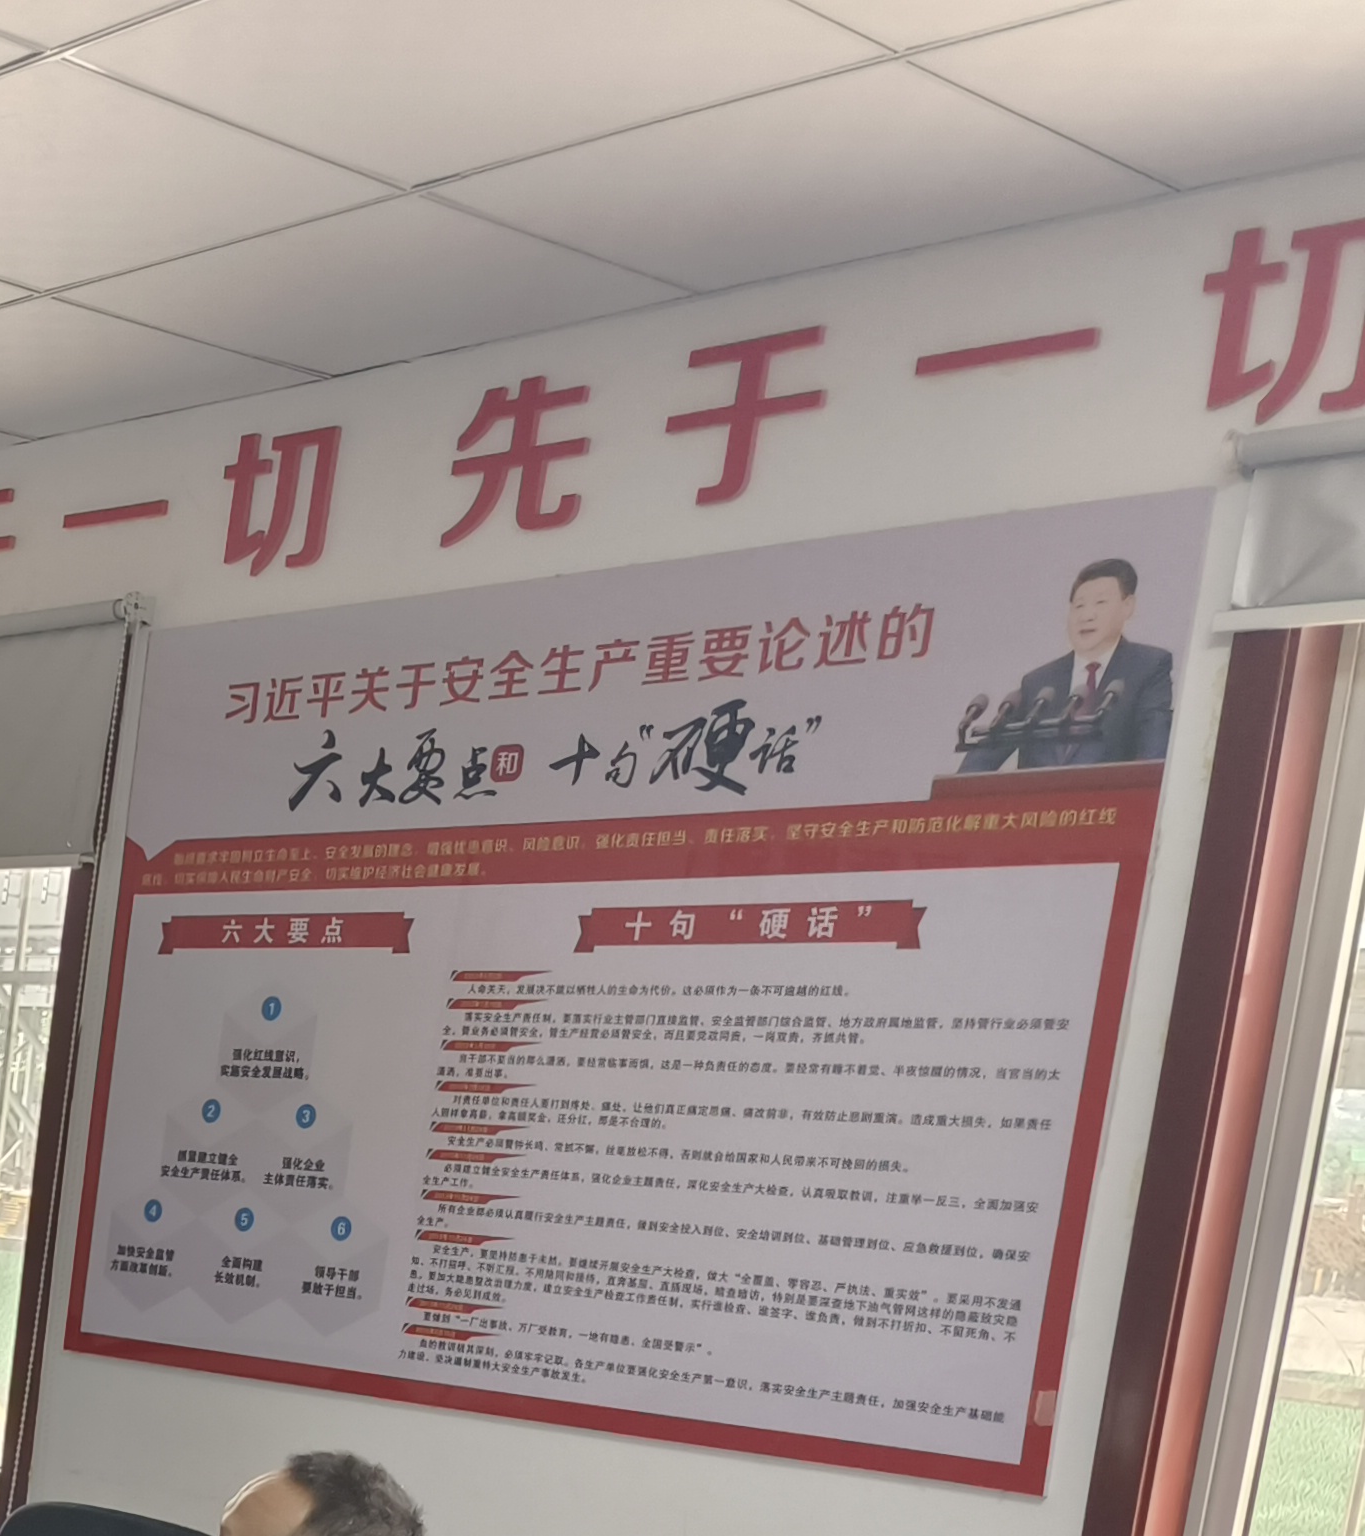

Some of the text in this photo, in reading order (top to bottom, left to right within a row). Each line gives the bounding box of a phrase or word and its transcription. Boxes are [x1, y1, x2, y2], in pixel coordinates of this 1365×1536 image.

[439, 218, 1365, 549] 先于一切
[224, 601, 936, 727] 习近平关于安全生产重要论述的
[288, 727, 500, 812] 六大要点
[495, 751, 521, 776] 和
[221, 917, 345, 945] 六大要点
[282, 1156, 325, 1173] 强化企业
